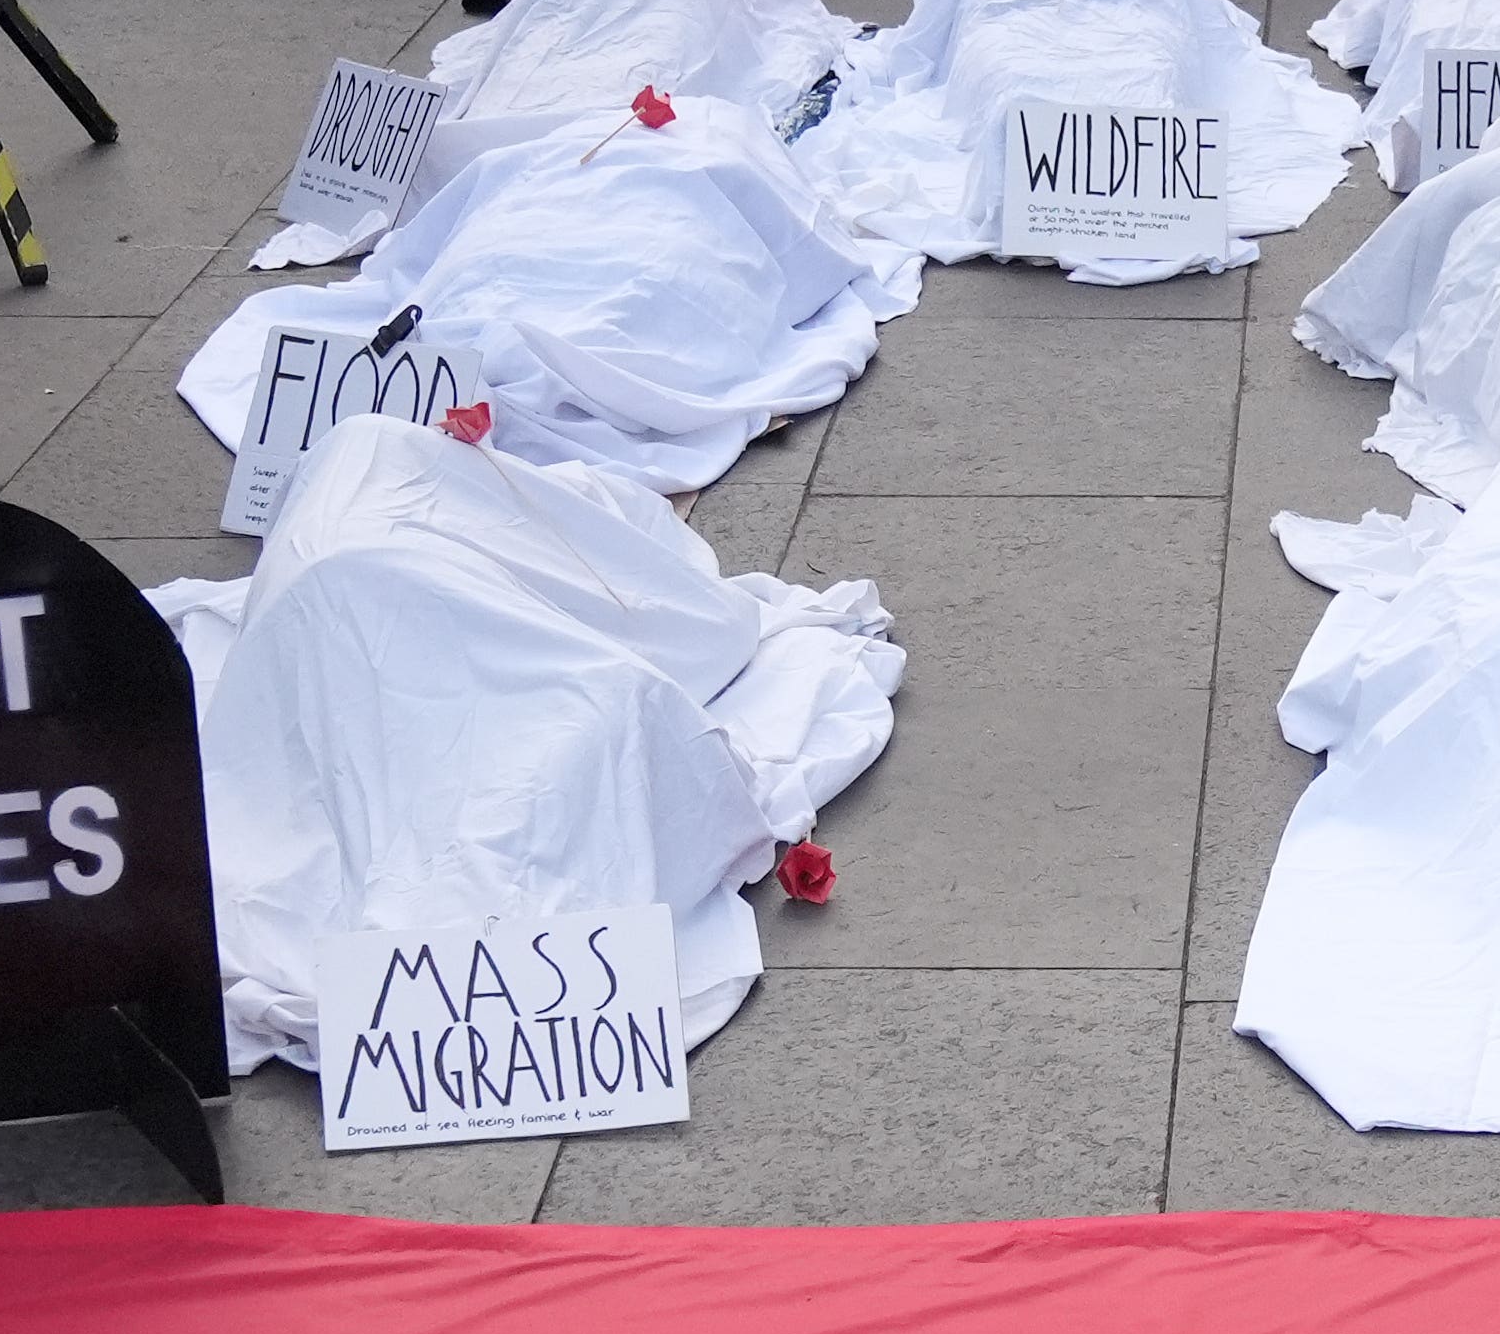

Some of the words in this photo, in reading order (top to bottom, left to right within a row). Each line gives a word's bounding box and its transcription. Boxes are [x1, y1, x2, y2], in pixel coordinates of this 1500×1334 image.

[307, 69, 441, 185] DROUGHT
[1019, 109, 1219, 200] WILDFIRE
[1065, 206, 1076, 217] by
[257, 333, 458, 451] FLOOD
[368, 925, 619, 1031] MASS
[337, 1005, 675, 1120] MIGRATION
[347, 1122, 408, 1138] Drowned
[415, 1122, 431, 1133] at
[437, 1120, 460, 1132] sea
[467, 1115, 516, 1130] fleeing
[520, 1111, 567, 1125] famine
[588, 1107, 616, 1119] war
